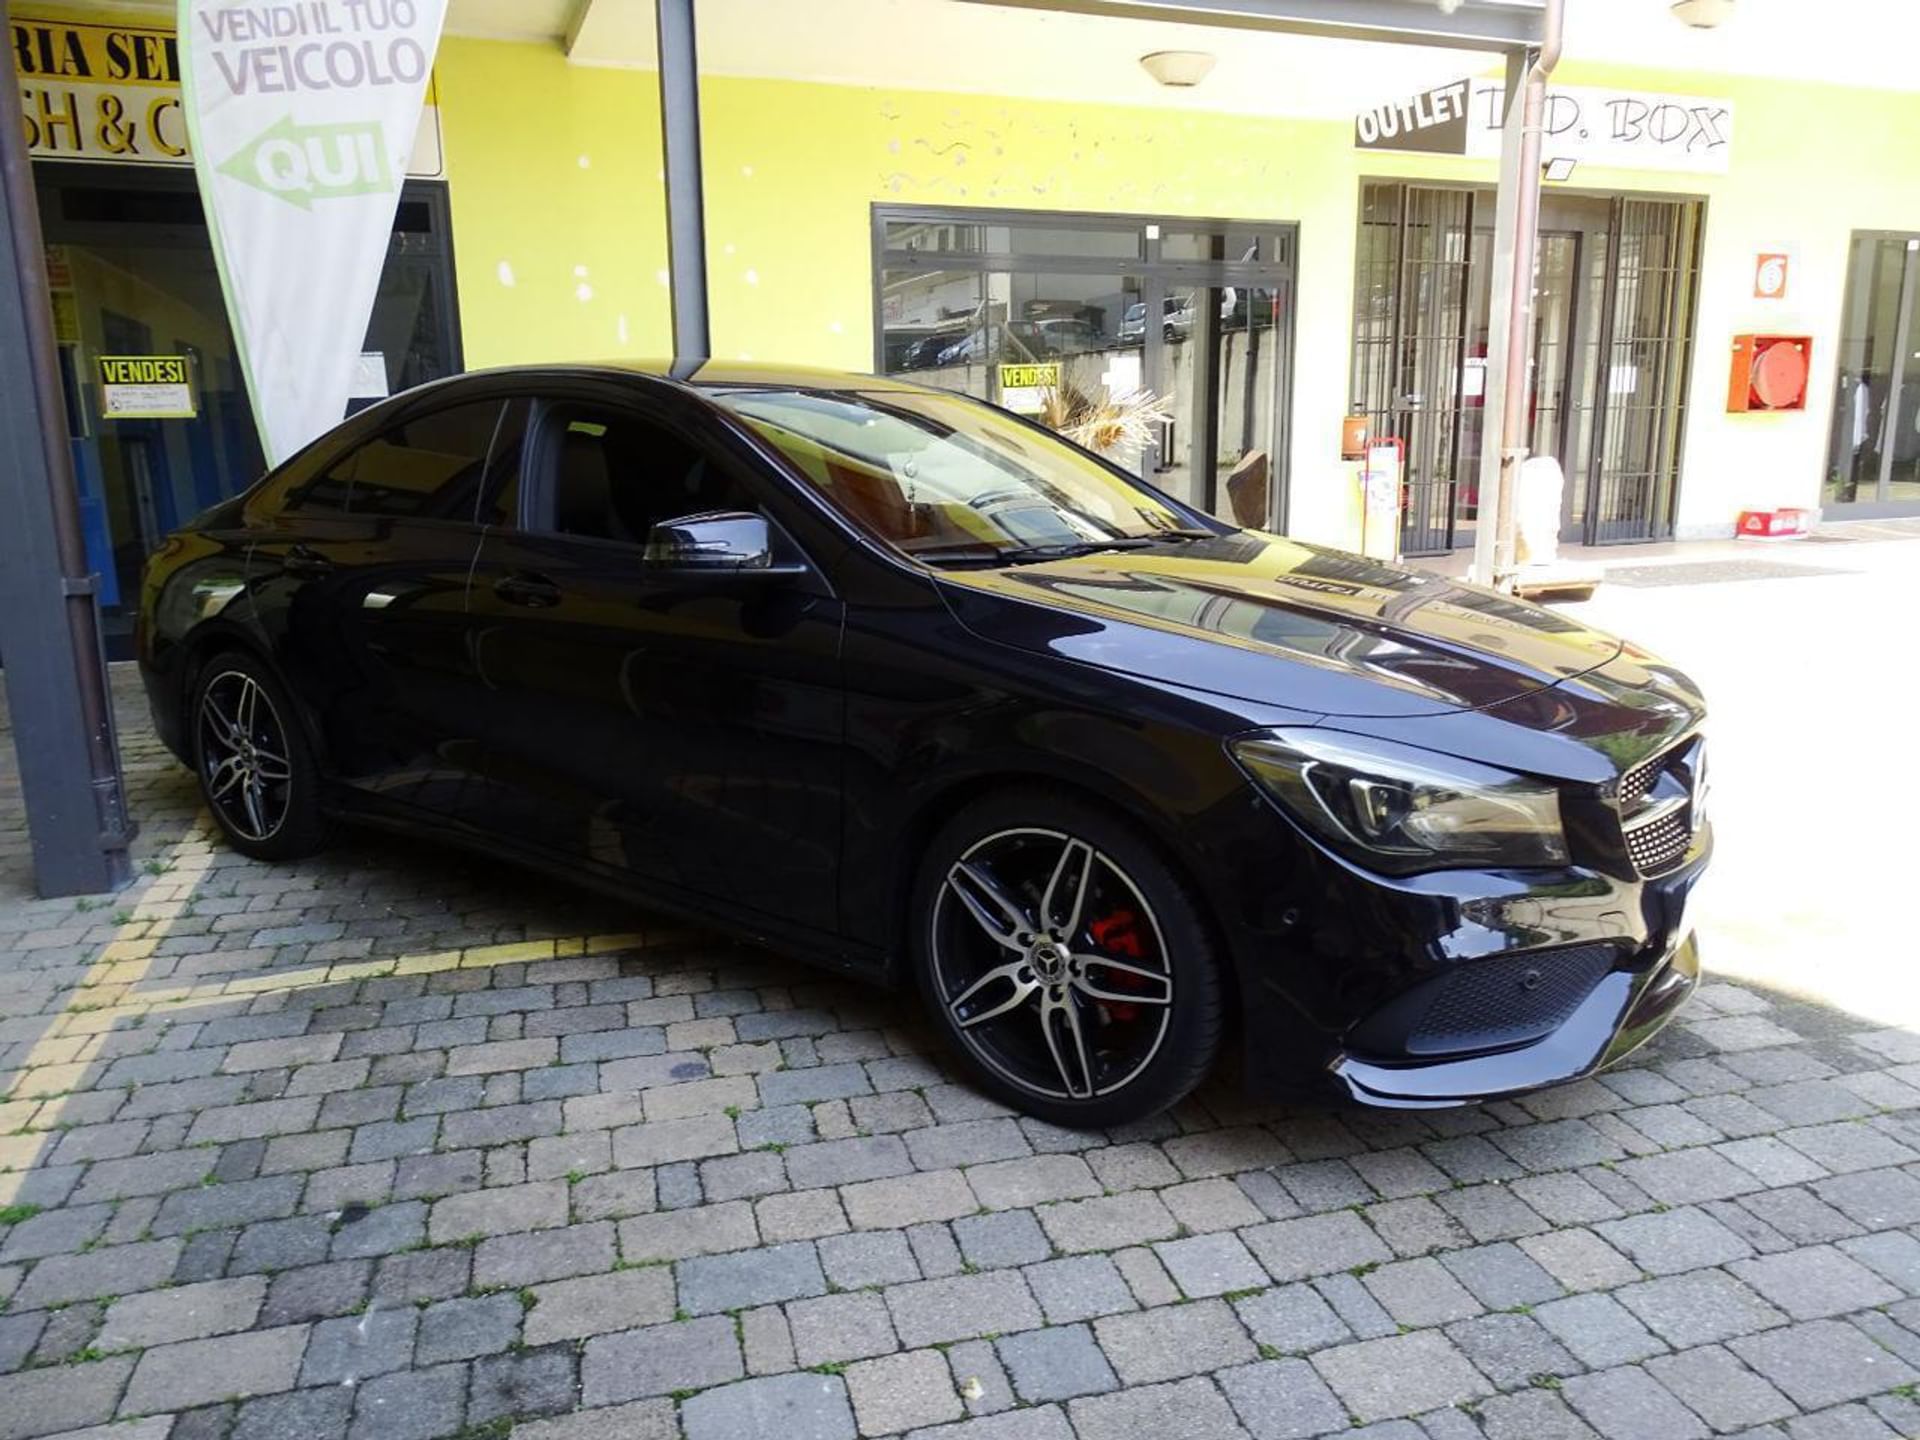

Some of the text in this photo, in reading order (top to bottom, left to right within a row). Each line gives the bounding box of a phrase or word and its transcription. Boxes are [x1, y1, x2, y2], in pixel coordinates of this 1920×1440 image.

[199, 0, 416, 42] VENDI IL TUO
[211, 37, 426, 95] VEICOLO
[97, 92, 139, 154] &
[1357, 83, 1466, 144] OUTLET
[1605, 98, 1728, 152] BOX
[255, 132, 380, 192] QUI
[102, 361, 185, 382] VENDESI
